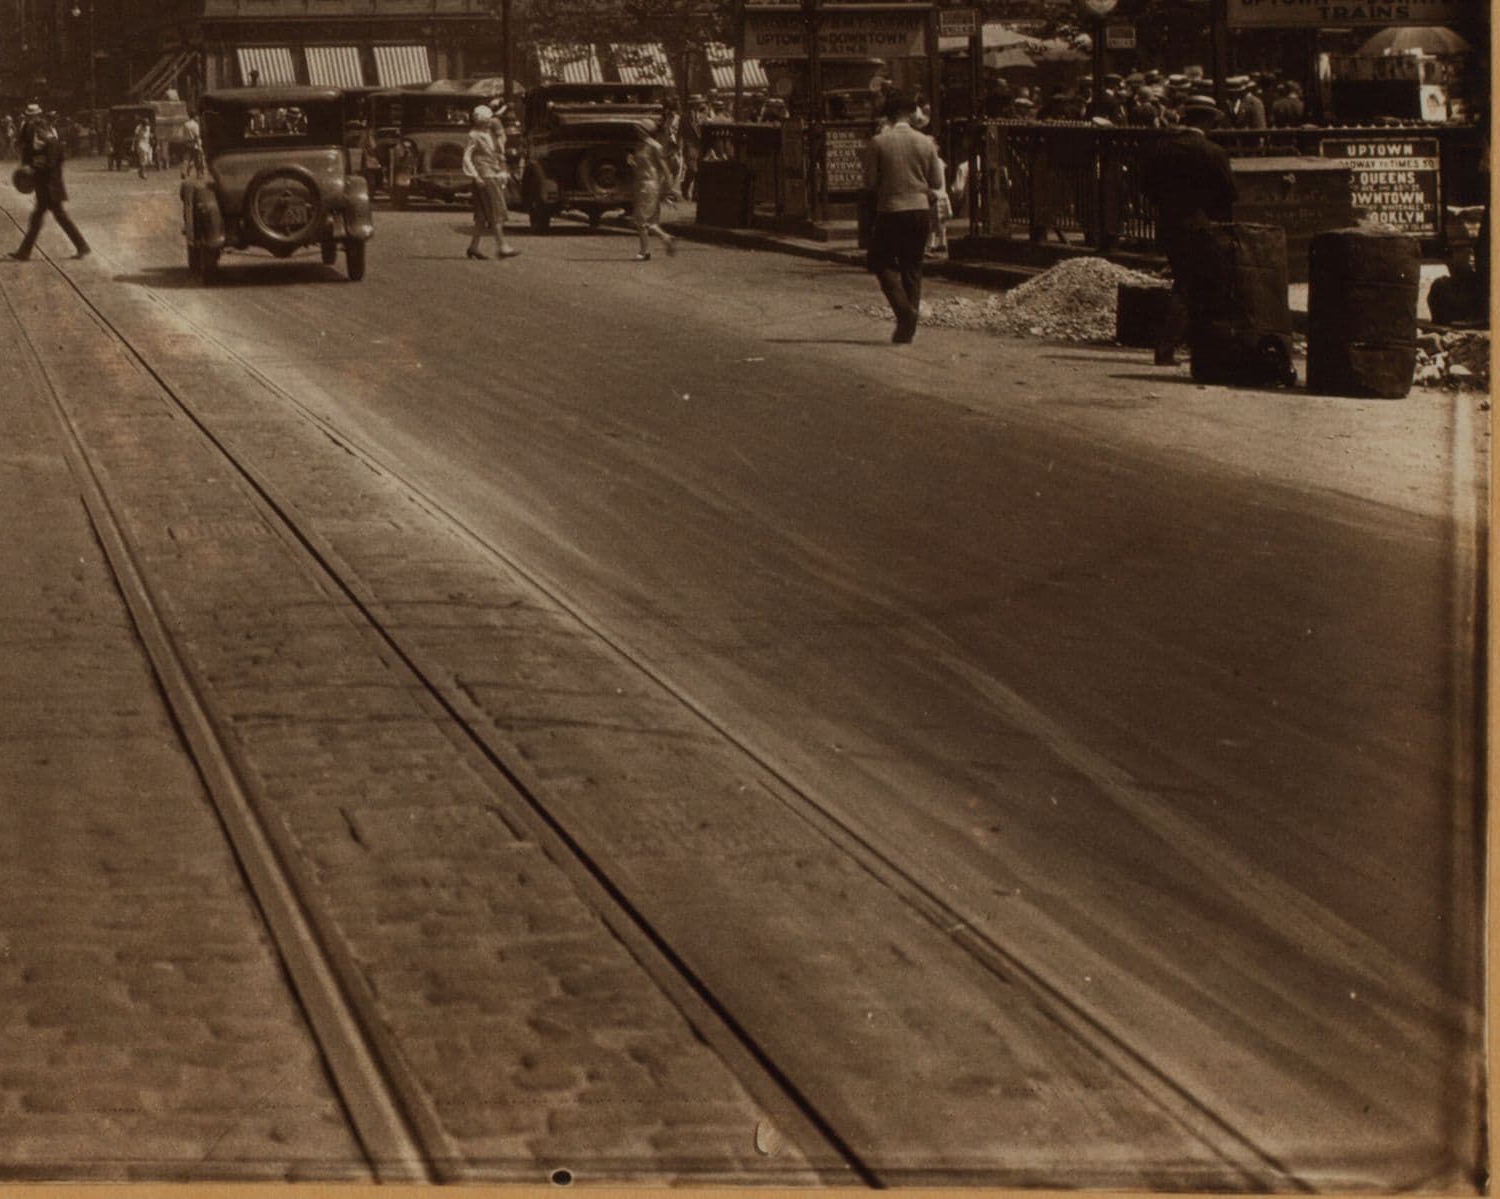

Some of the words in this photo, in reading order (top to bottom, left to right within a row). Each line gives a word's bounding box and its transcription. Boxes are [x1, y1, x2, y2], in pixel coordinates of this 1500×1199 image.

[1318, 6, 1410, 20] TRAINS
[755, 31, 804, 46] UPTOW
[828, 29, 908, 45] DOWNTOWN
[1345, 143, 1414, 158] UPTOWN
[1390, 160, 1420, 170] TIMES
[1360, 171, 1416, 186] QUEENS
